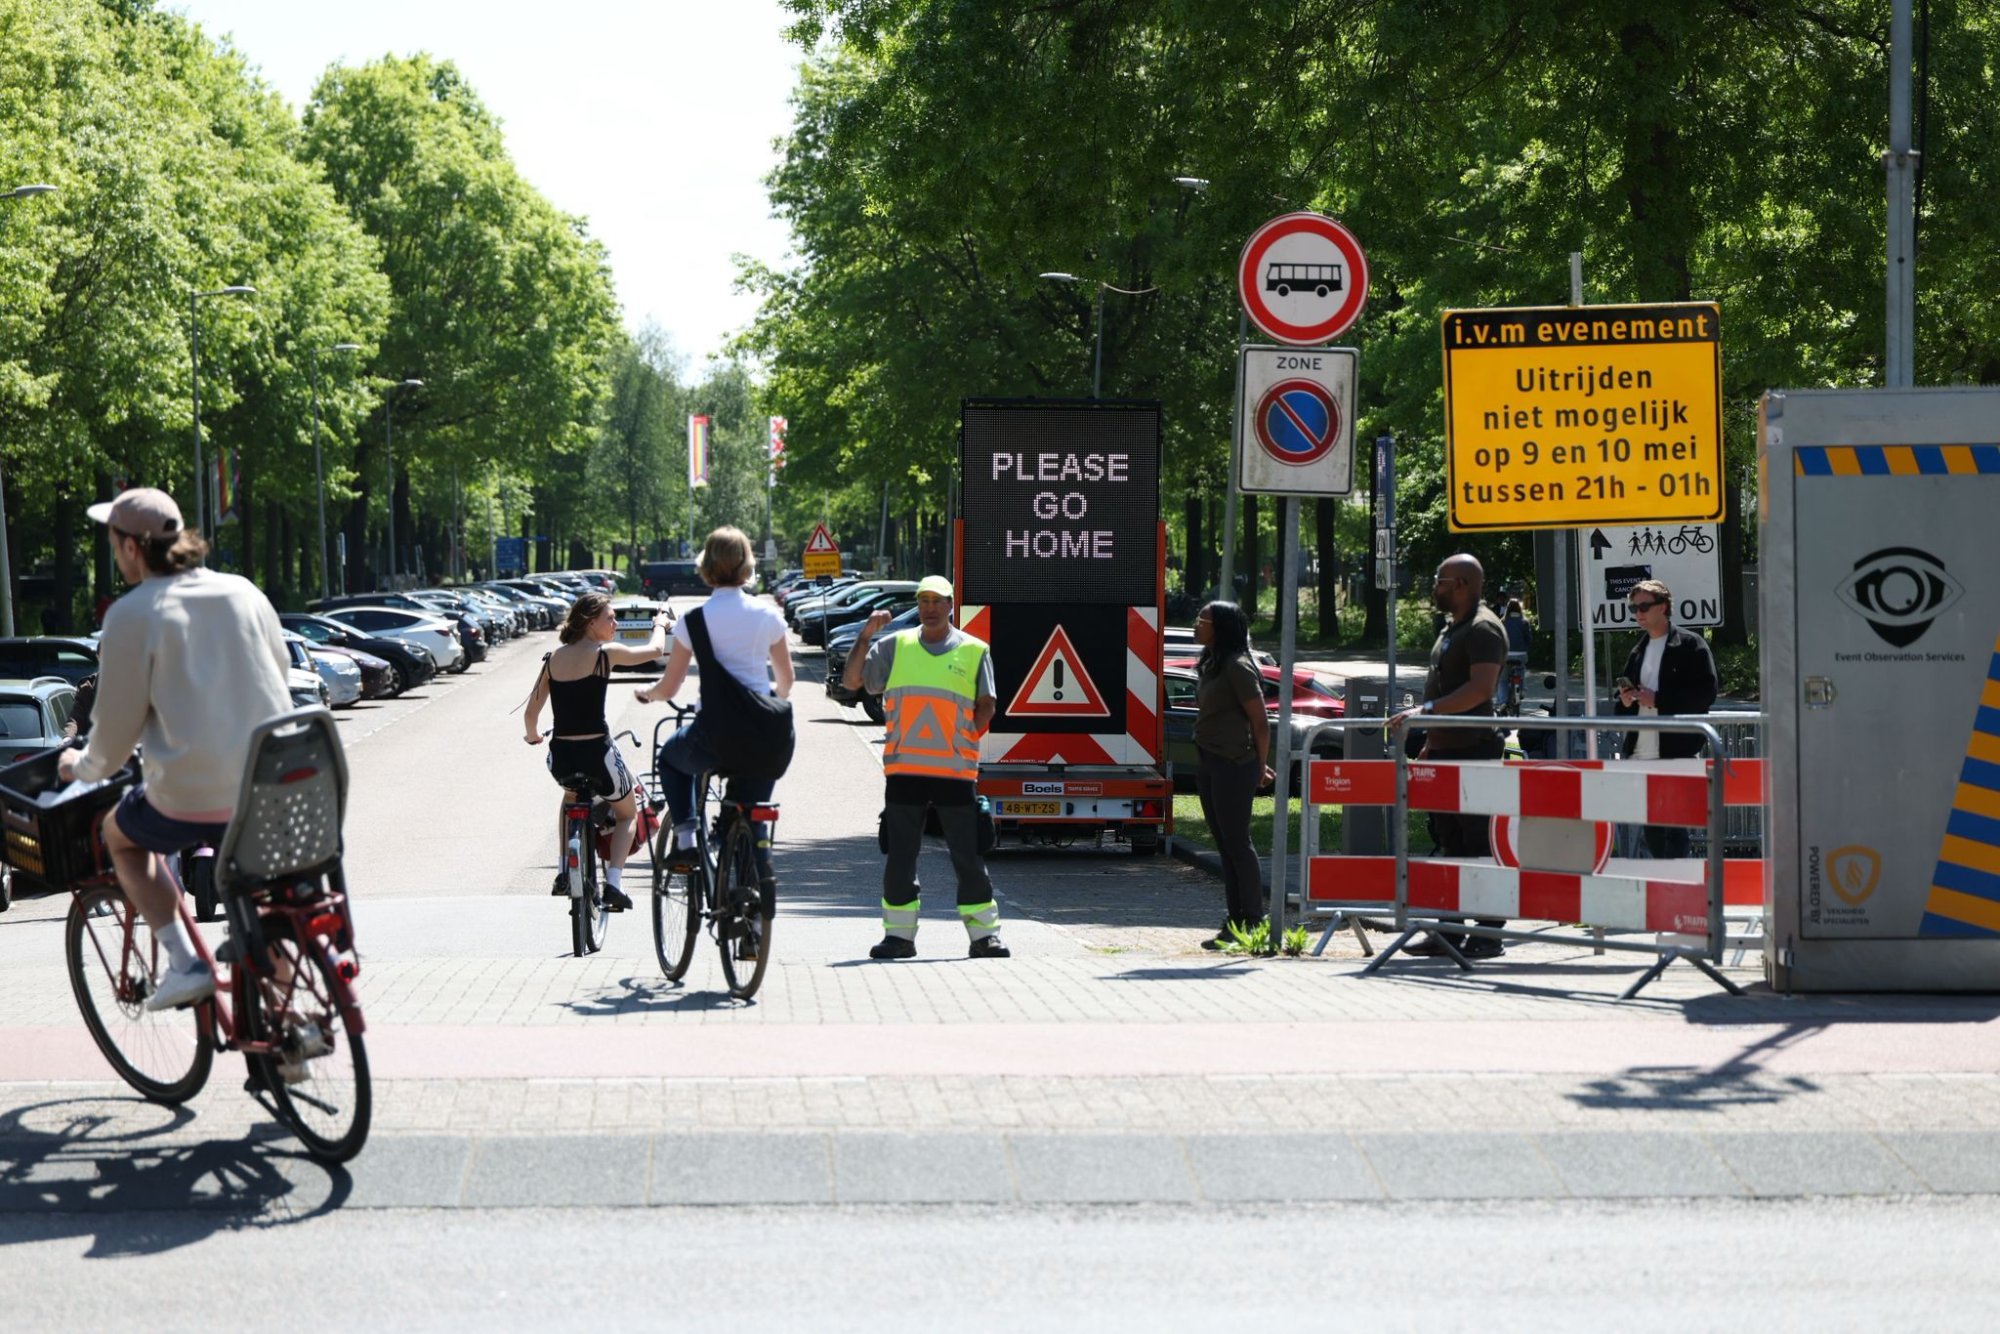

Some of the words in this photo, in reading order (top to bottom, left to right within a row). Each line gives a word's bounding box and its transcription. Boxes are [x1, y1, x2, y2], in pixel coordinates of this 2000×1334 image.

[1455, 319, 1525, 344] i.v.m
[1537, 314, 1708, 341] evenement
[1276, 357, 1322, 370] ZONE
[1516, 366, 1652, 396] Uitrijden
[1484, 405, 1543, 429] niet
[1556, 400, 1689, 432] mogelijk
[992, 453, 1128, 481] PLEASE
[1475, 447, 1510, 472] op
[1522, 442, 1539, 465] 9
[1551, 444, 1586, 464] en
[1597, 438, 1630, 462] 10
[1644, 435, 1697, 461] mei
[1463, 481, 1563, 504] tussen
[1576, 475, 1625, 500] 21h
[1659, 472, 1710, 497] 01h
[1033, 491, 1087, 519] GO
[1006, 530, 1113, 558] HOME
[1835, 653, 1862, 662] Event
[1864, 653, 1923, 662] Observation
[1925, 653, 1965, 662] Services
[1324, 777, 1351, 787] Trigion
[1412, 767, 1436, 778] TRAFFIC
[1024, 784, 1062, 793] Boels
[1006, 803, 1055, 813] 48-WT-ZS
[1808, 846, 1820, 907] POWERED
[1810, 909, 1821, 925] BY
